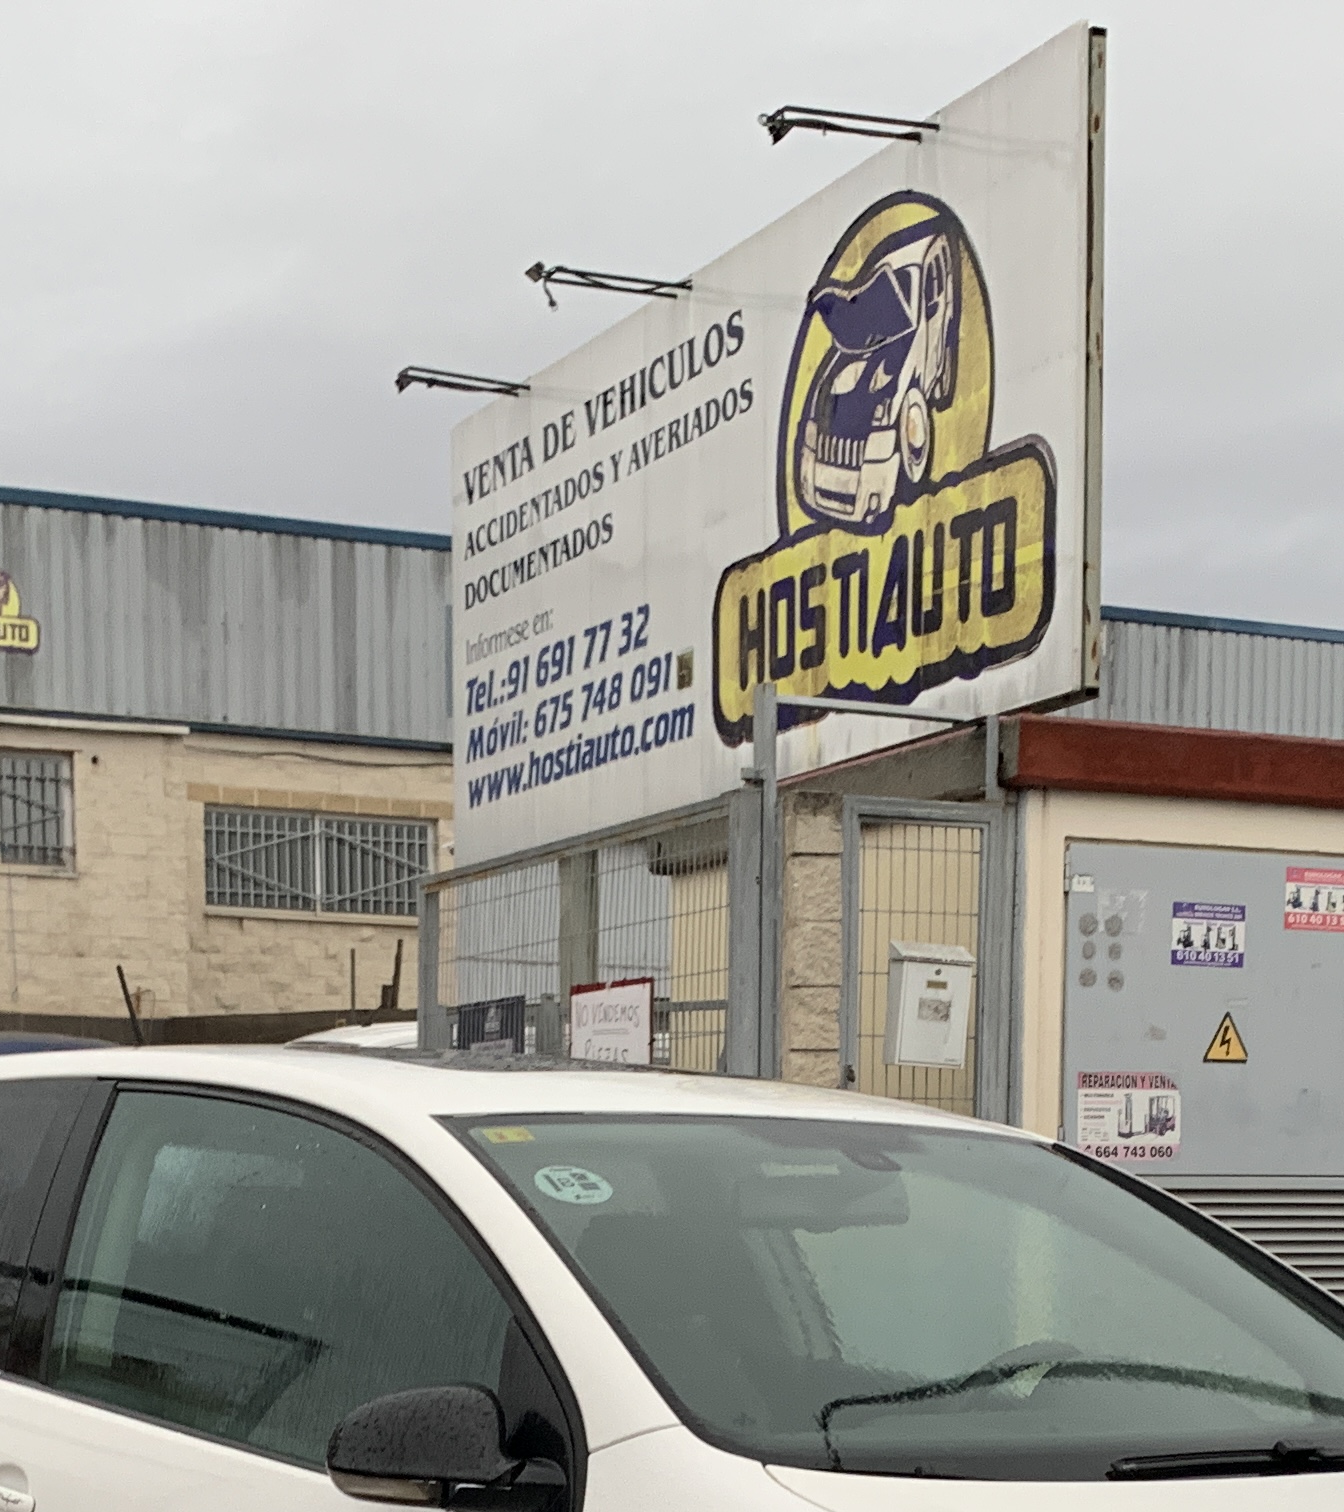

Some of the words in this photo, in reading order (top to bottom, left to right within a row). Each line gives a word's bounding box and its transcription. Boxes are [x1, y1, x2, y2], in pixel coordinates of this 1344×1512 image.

[464, 436, 534, 505] VENTA
[543, 410, 576, 463] DE
[584, 309, 745, 437] VEHICULOS
[464, 461, 604, 560] ACCIDENTADOS
[610, 449, 624, 484] Y
[627, 378, 754, 476] AVERIADOS
[464, 512, 614, 610] DOCUMENTADOS
[739, 495, 1018, 691] HOSTIAUTO
[536, 635, 576, 688] 691
[583, 619, 613, 671] 77
[617, 603, 650, 656] 32
[465, 709, 529, 764] Móvil:
[534, 689, 574, 739] 675
[581, 672, 623, 722] 748
[630, 651, 673, 702] 091
[467, 702, 695, 809] www.hostiauto.com
[1176, 951, 1197, 961] 610
[1198, 951, 1212, 962] 40
[1213, 952, 1226, 962] 13
[1226, 953, 1240, 963] 51
[1287, 913, 1308, 924] 610
[1309, 914, 1323, 925] 40
[1326, 915, 1338, 926] 13
[1081, 1074, 1138, 1089] REPARACION
[1140, 1075, 1146, 1089] Y
[1095, 1146, 1118, 1158] 664
[1123, 1146, 1146, 1158] 743
[1150, 1146, 1173, 1158] 060
